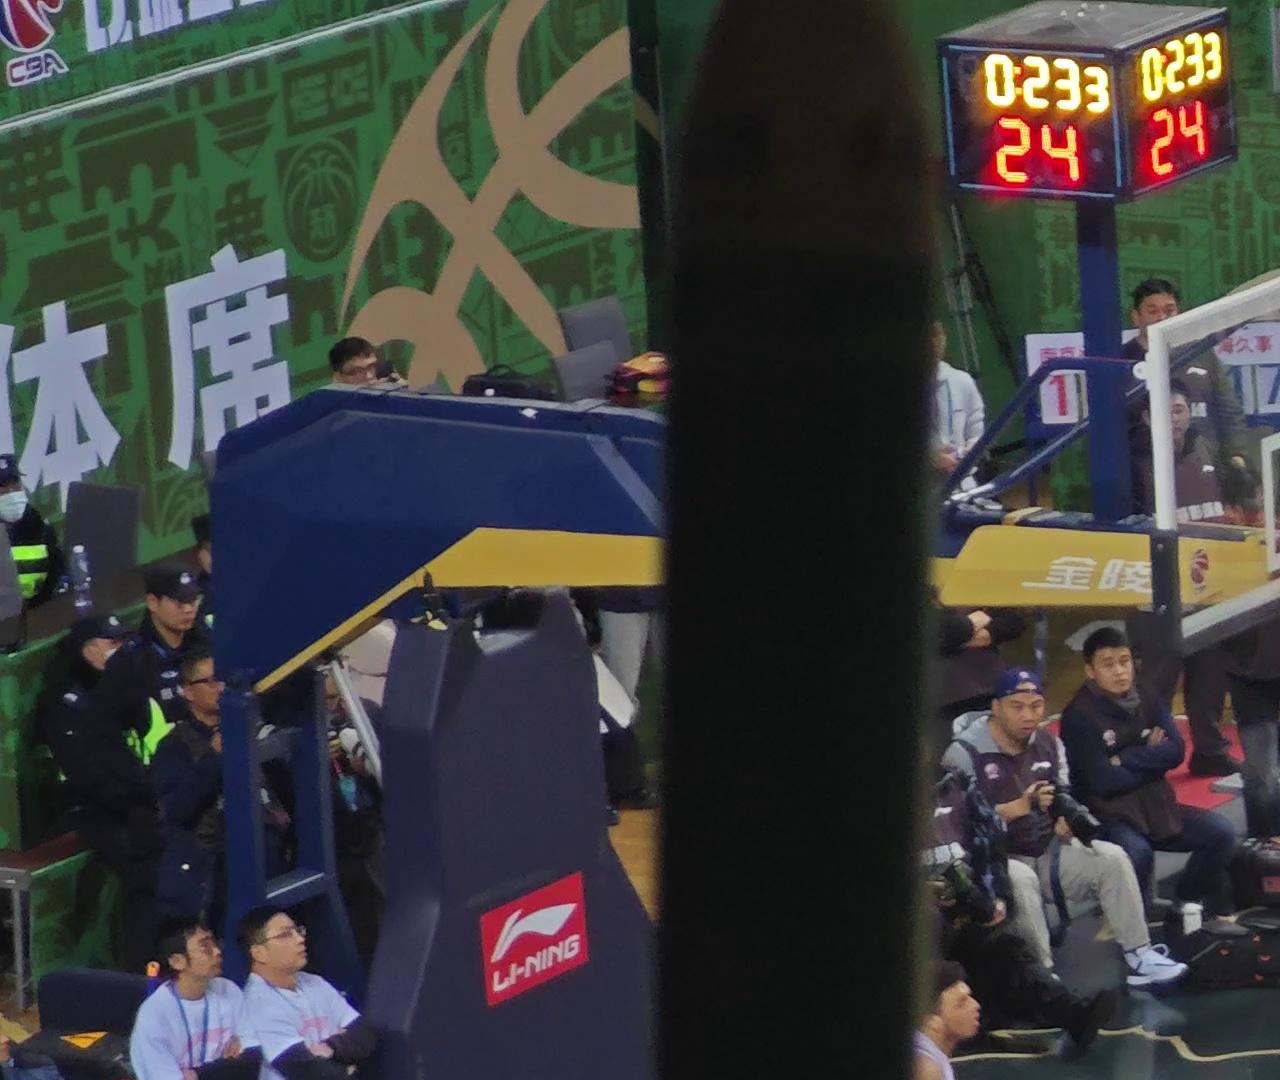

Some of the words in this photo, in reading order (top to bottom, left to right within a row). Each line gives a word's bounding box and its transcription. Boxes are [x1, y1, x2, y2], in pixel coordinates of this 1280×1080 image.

[996, 117, 1079, 183] 24
[1151, 101, 1205, 175] 24
[0, 242, 292, 513] 体席
[493, 934, 580, 992] LI-NING
